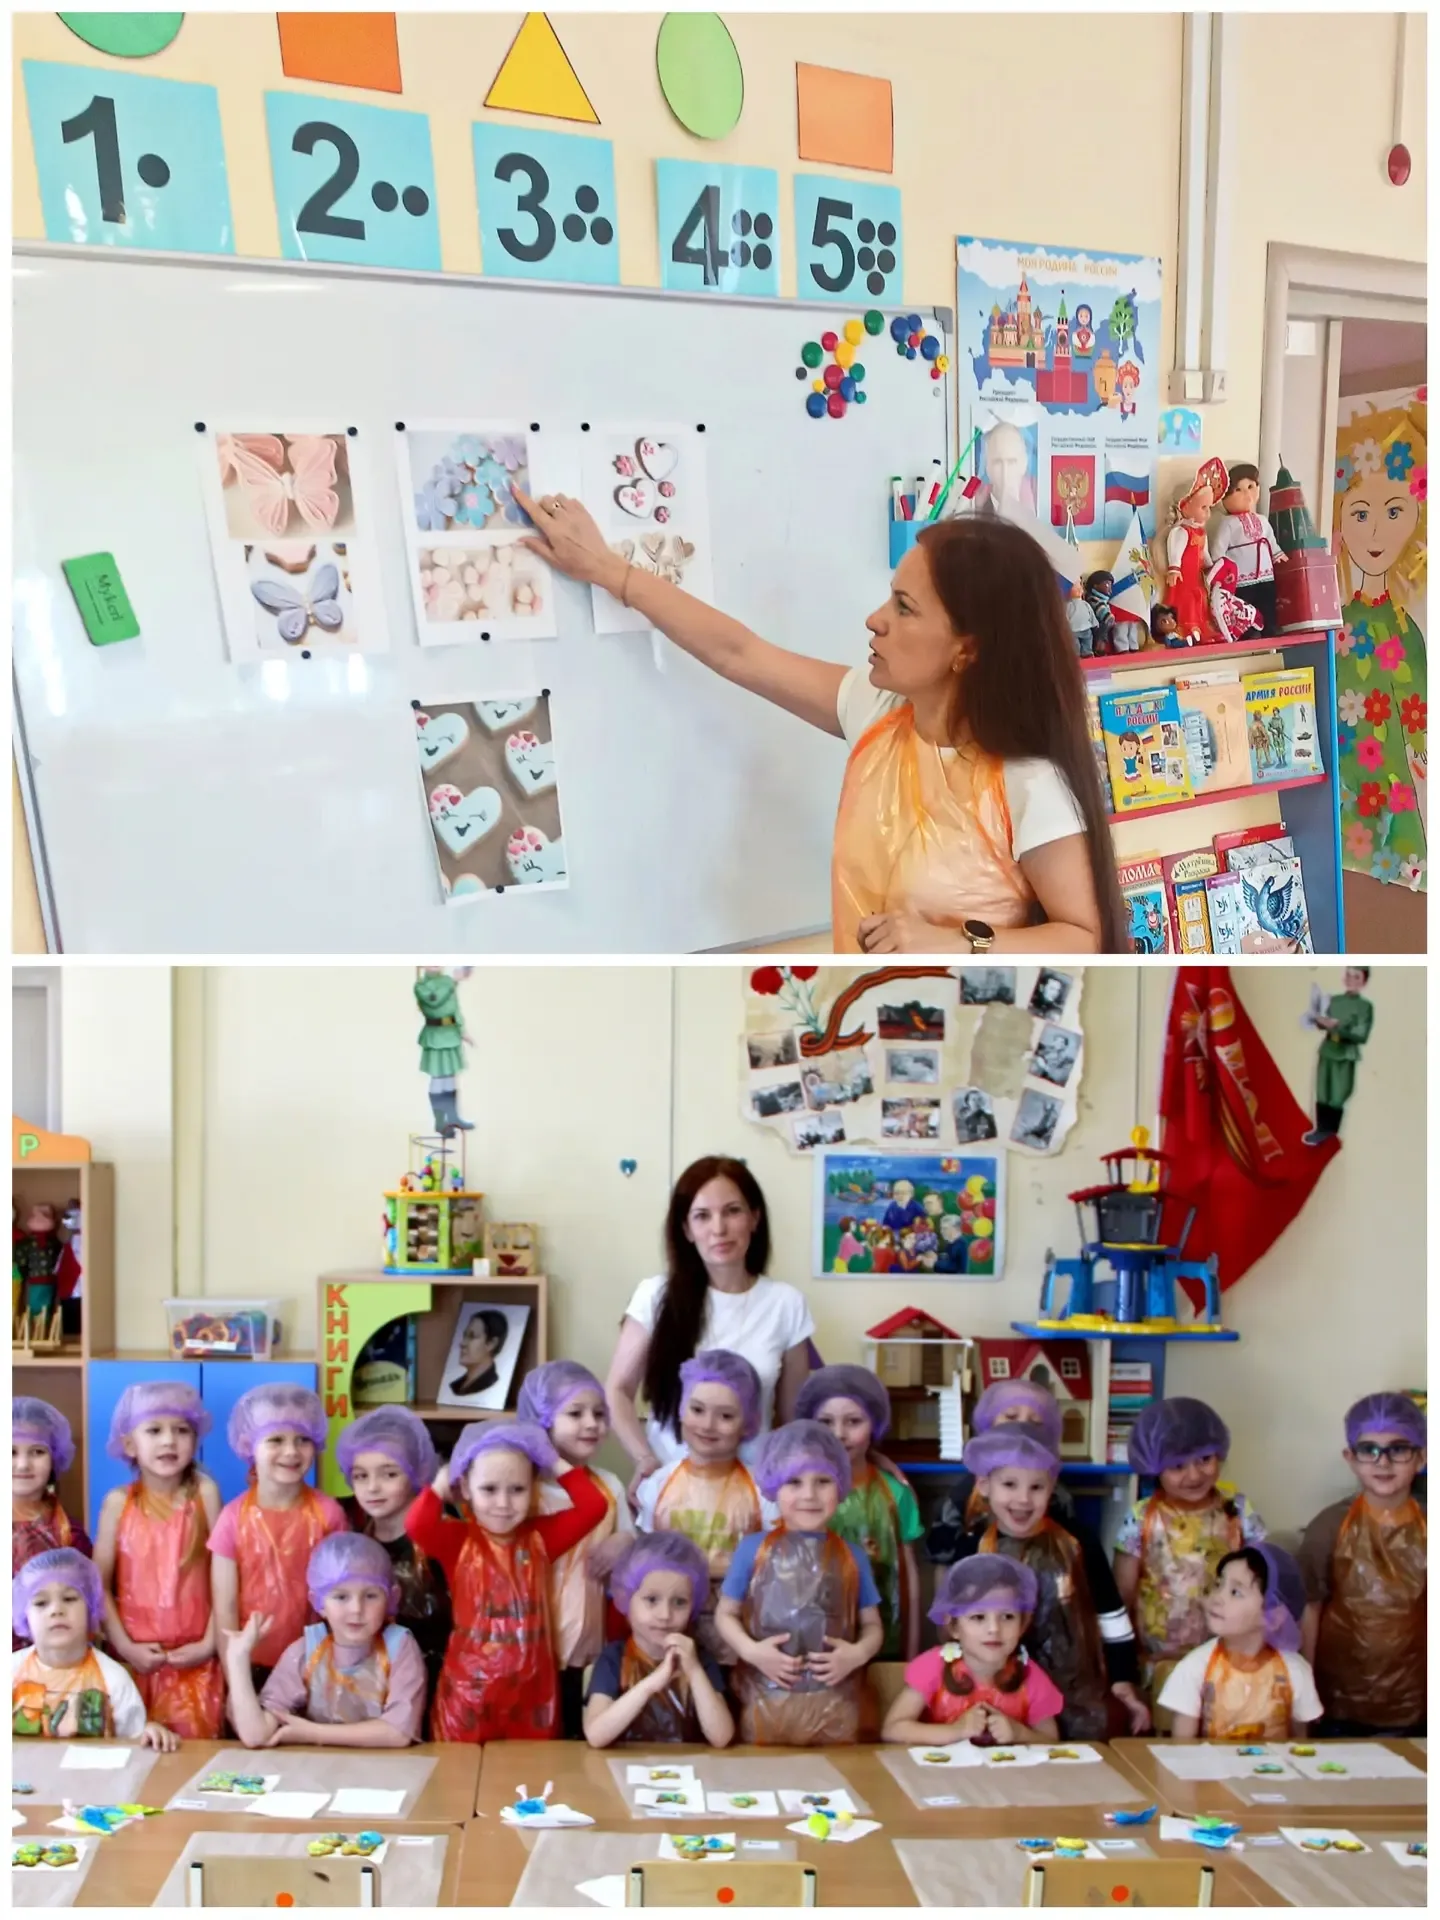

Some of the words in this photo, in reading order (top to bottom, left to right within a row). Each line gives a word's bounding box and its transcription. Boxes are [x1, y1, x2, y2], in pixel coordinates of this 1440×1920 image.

[60, 95, 126, 225] 1
[291, 120, 367, 241] 2
[493, 151, 557, 263] 3
[672, 185, 729, 286] 4
[809, 196, 856, 293] 5
[1245, 688, 1276, 701] АРМИЯ
[1278, 683, 1312, 698] РОССИИ
[20, 1134, 40, 1158] Р
[326, 1284, 348, 1418] КНИГИ
